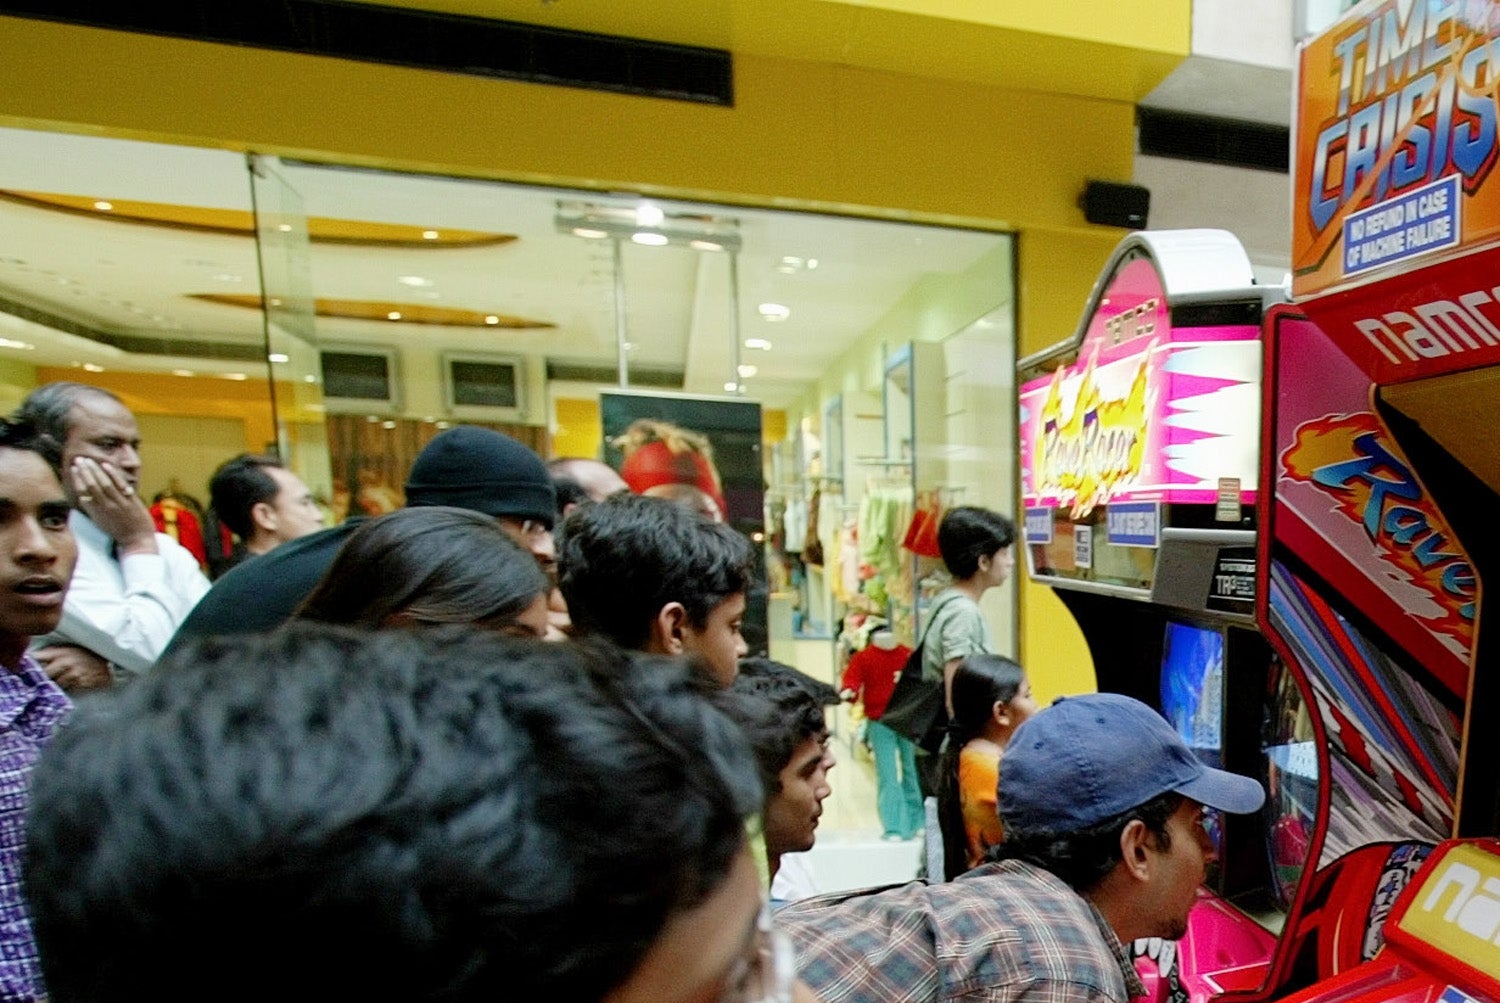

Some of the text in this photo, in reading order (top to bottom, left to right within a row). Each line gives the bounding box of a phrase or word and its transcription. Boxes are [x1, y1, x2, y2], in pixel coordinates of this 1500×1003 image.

[1334, 0, 1464, 118] TIME
[1365, 203, 1405, 238] REFUND
[1419, 187, 1448, 219] CASE
[1361, 230, 1405, 264] MACHINE
[1406, 215, 1451, 251] FAILURE
